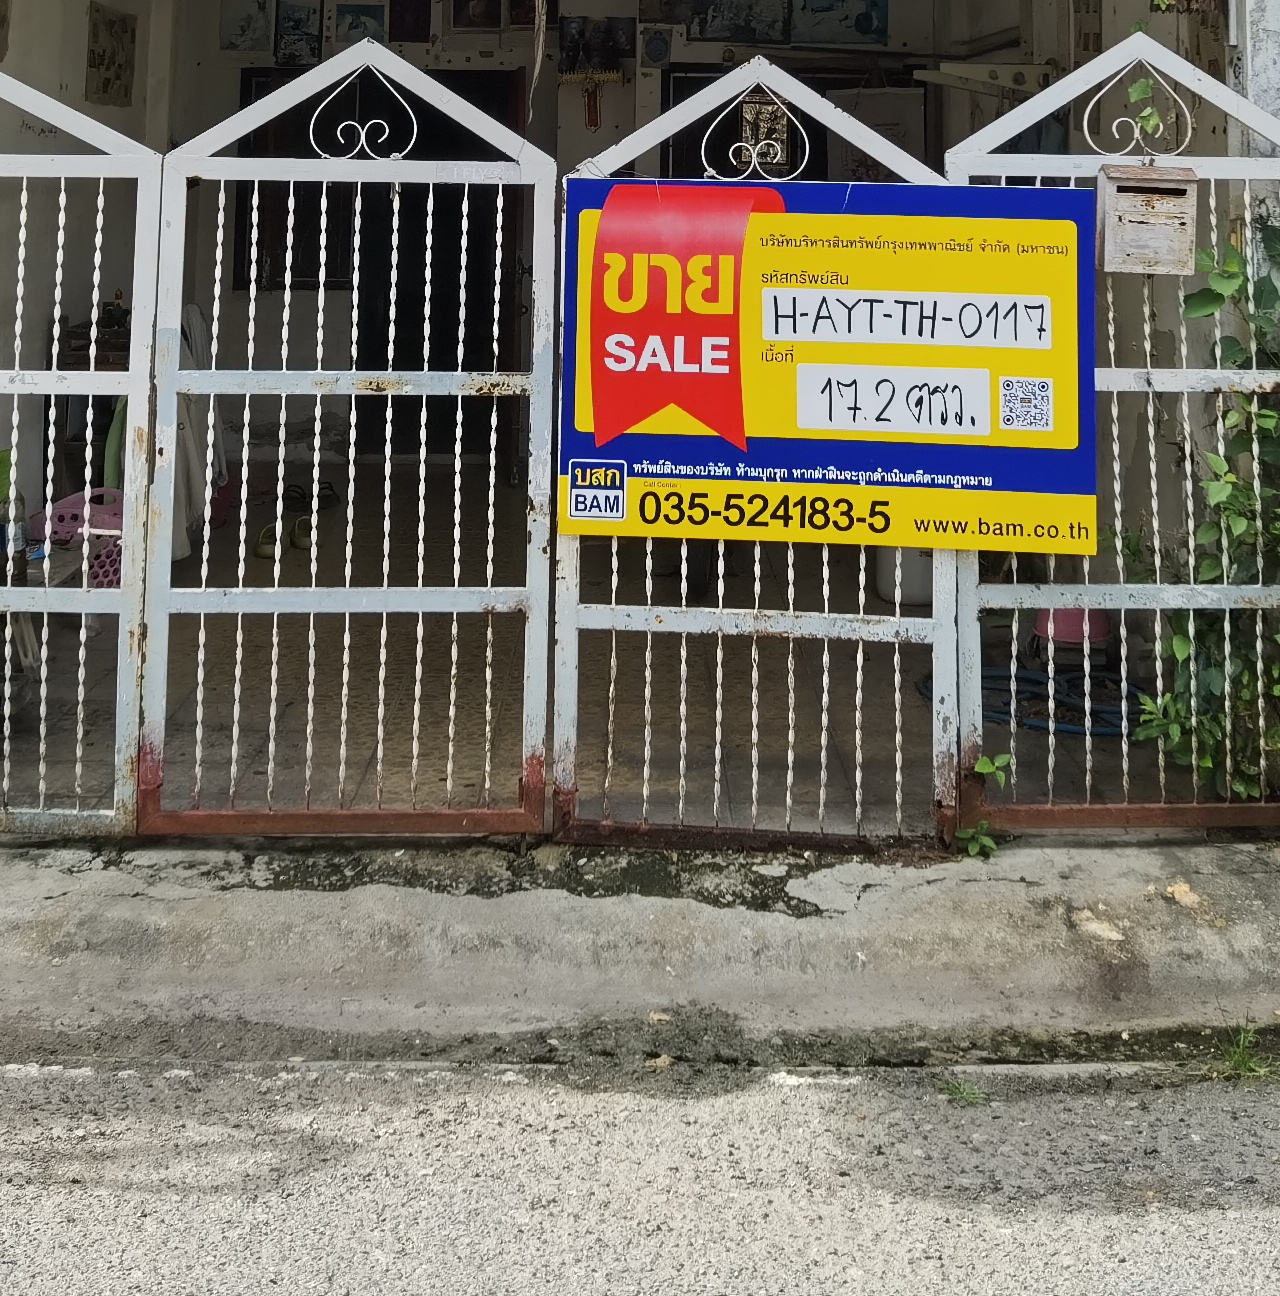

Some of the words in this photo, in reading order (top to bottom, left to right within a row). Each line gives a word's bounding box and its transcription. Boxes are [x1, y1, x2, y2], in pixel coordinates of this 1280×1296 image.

[759, 233, 974, 256] บริษัทบริหารสินทรัพย์กรุงเทพพาณิชย์
[978, 239, 1011, 253] จำกัด
[1016, 242, 1070, 257] (มหาชน)
[603, 252, 735, 315] ขาย
[761, 269, 850, 286] รหัสทรัพย์สิน
[773, 295, 1047, 342] H-AYT-TH-0117
[604, 334, 730, 374] SALE
[761, 343, 794, 364] เนื้อที่
[574, 467, 620, 487] บสก
[632, 459, 731, 477] ทรัพย์สินของบริษัท
[735, 463, 788, 483] ห้ามบุกรุก
[574, 493, 620, 513] BAM
[638, 490, 891, 534] 035-524183-5
[913, 517, 1089, 540] www.bam.co.th
